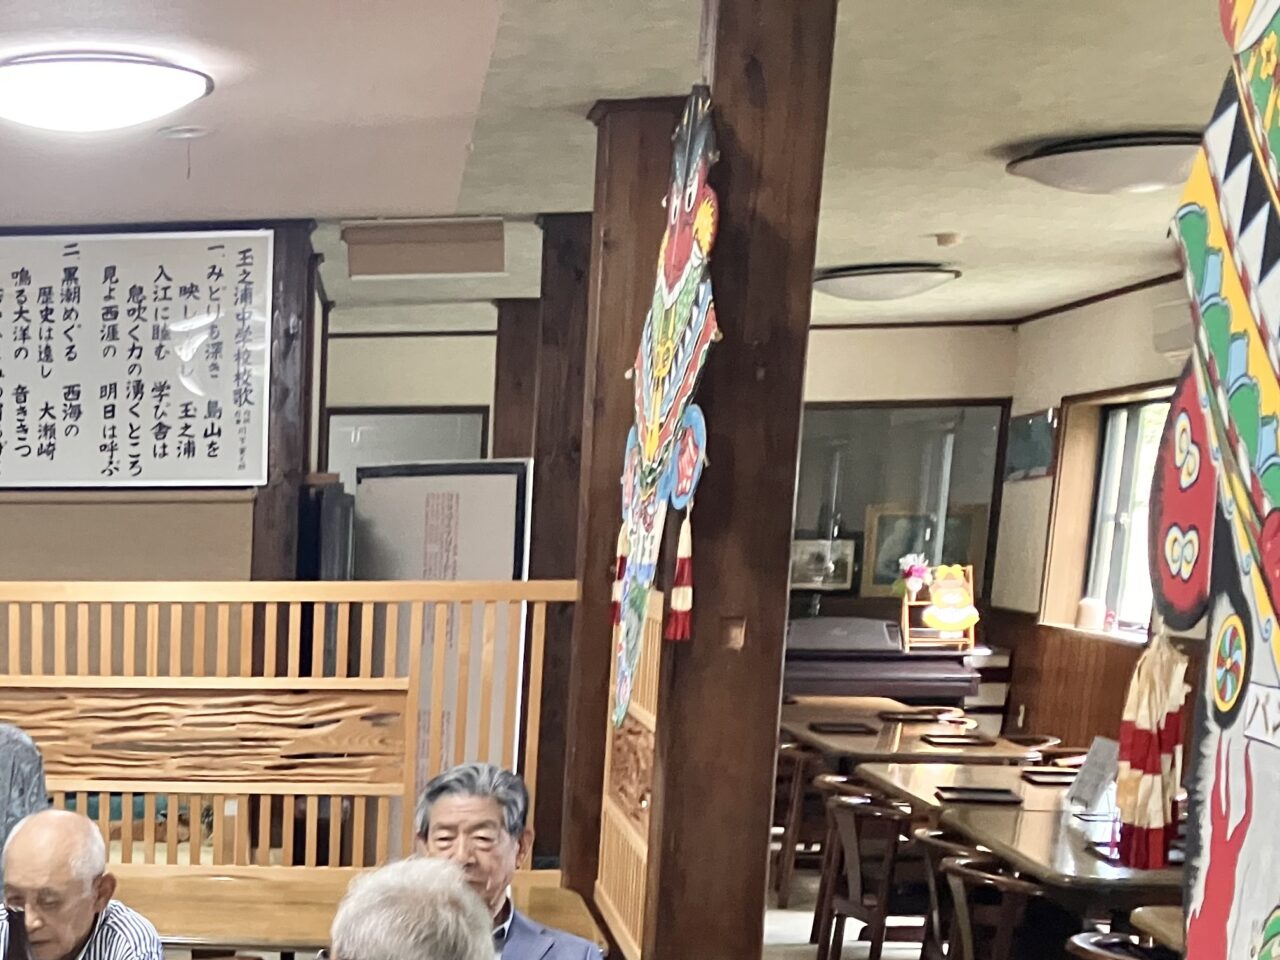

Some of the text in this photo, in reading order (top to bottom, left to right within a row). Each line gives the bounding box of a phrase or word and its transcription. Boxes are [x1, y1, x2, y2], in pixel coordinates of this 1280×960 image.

[37, 401, 57, 461] 大瀬崎
[178, 401, 197, 458] 玉之浦
